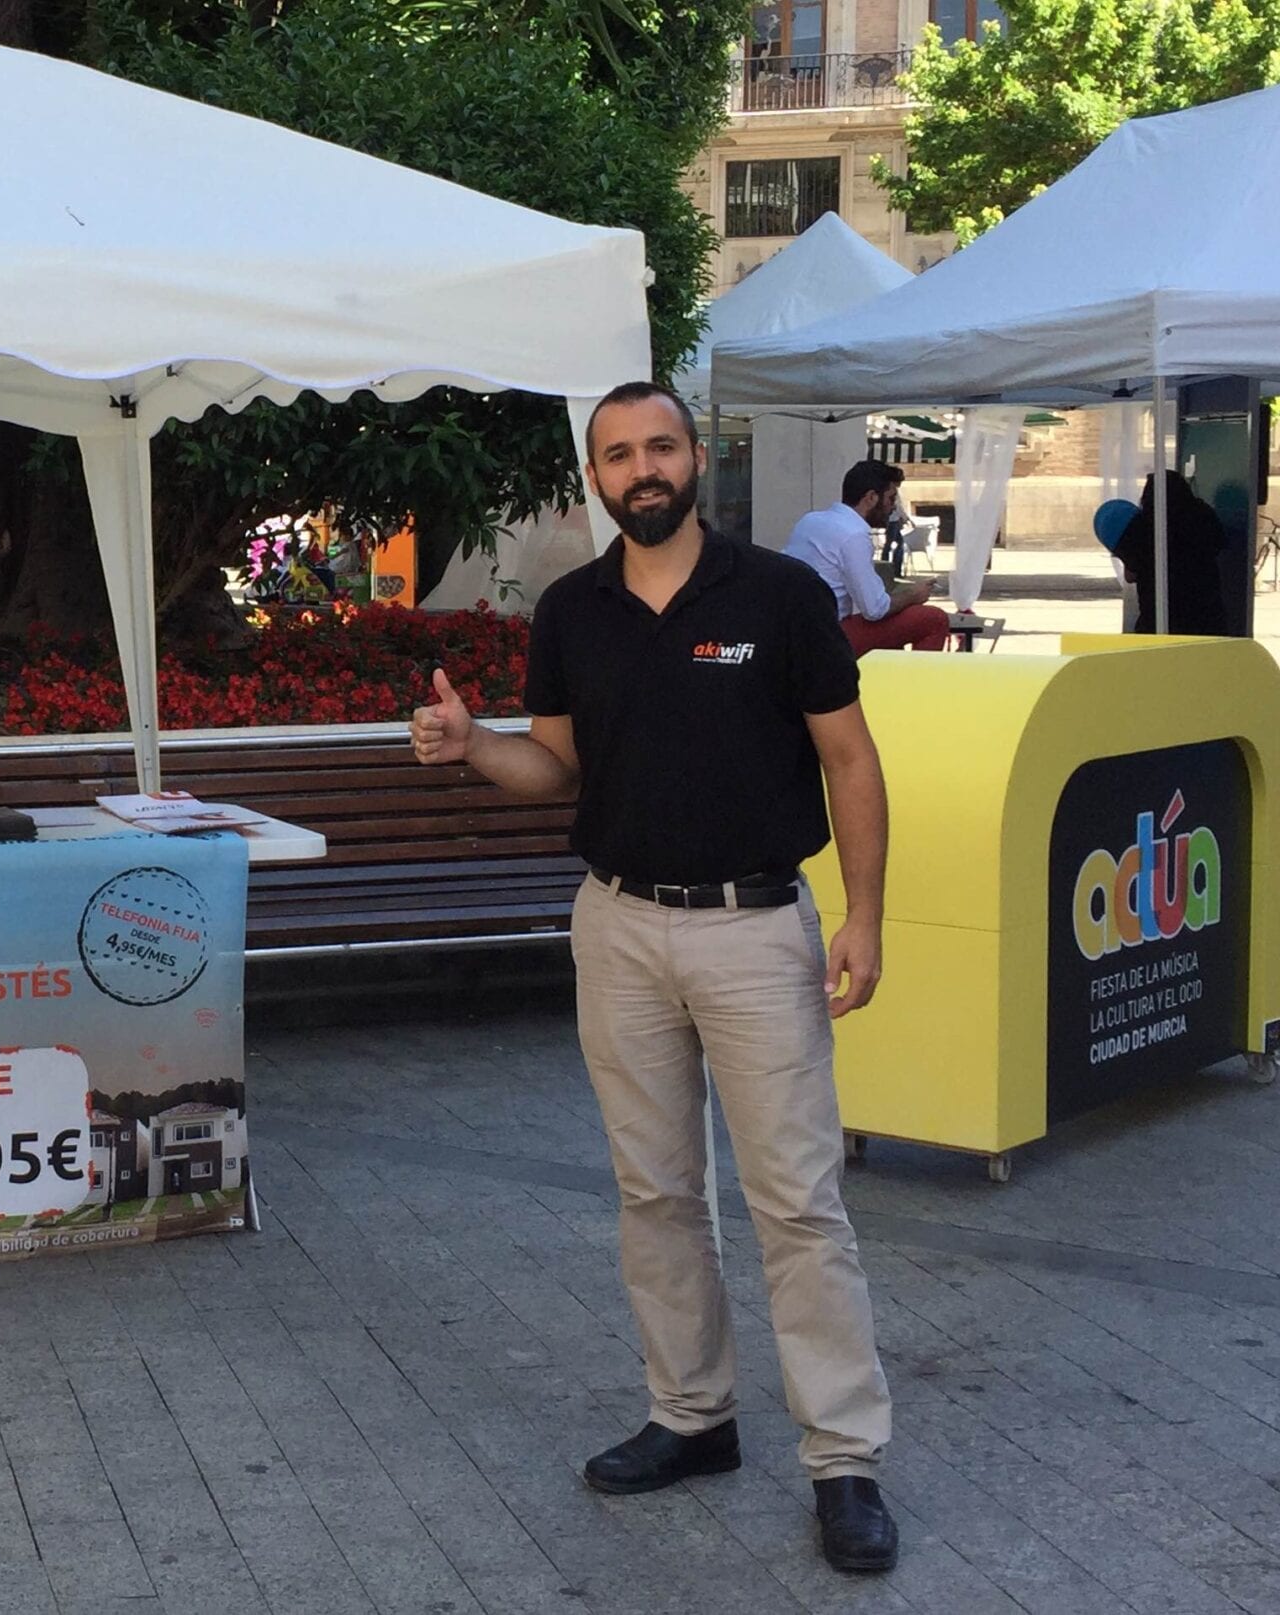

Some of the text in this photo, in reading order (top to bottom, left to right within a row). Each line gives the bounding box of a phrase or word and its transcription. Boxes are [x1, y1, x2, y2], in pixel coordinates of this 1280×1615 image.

[693, 641, 755, 664] akiwifi
[1073, 788, 1221, 961] actúa
[100, 902, 200, 944] TELEFONIA FIJA
[130, 928, 162, 944] DESDE
[106, 932, 177, 967] 4,95€/MES
[1091, 951, 1199, 1001] FIESTA DE LA MÚSICA
[1090, 979, 1202, 1034] LA CULTURA Y EL OCIO
[1090, 1014, 1187, 1065] CIUDAD DE MURCIA
[52, 1233, 70, 1246] de
[72, 1226, 139, 1245] cobertura
